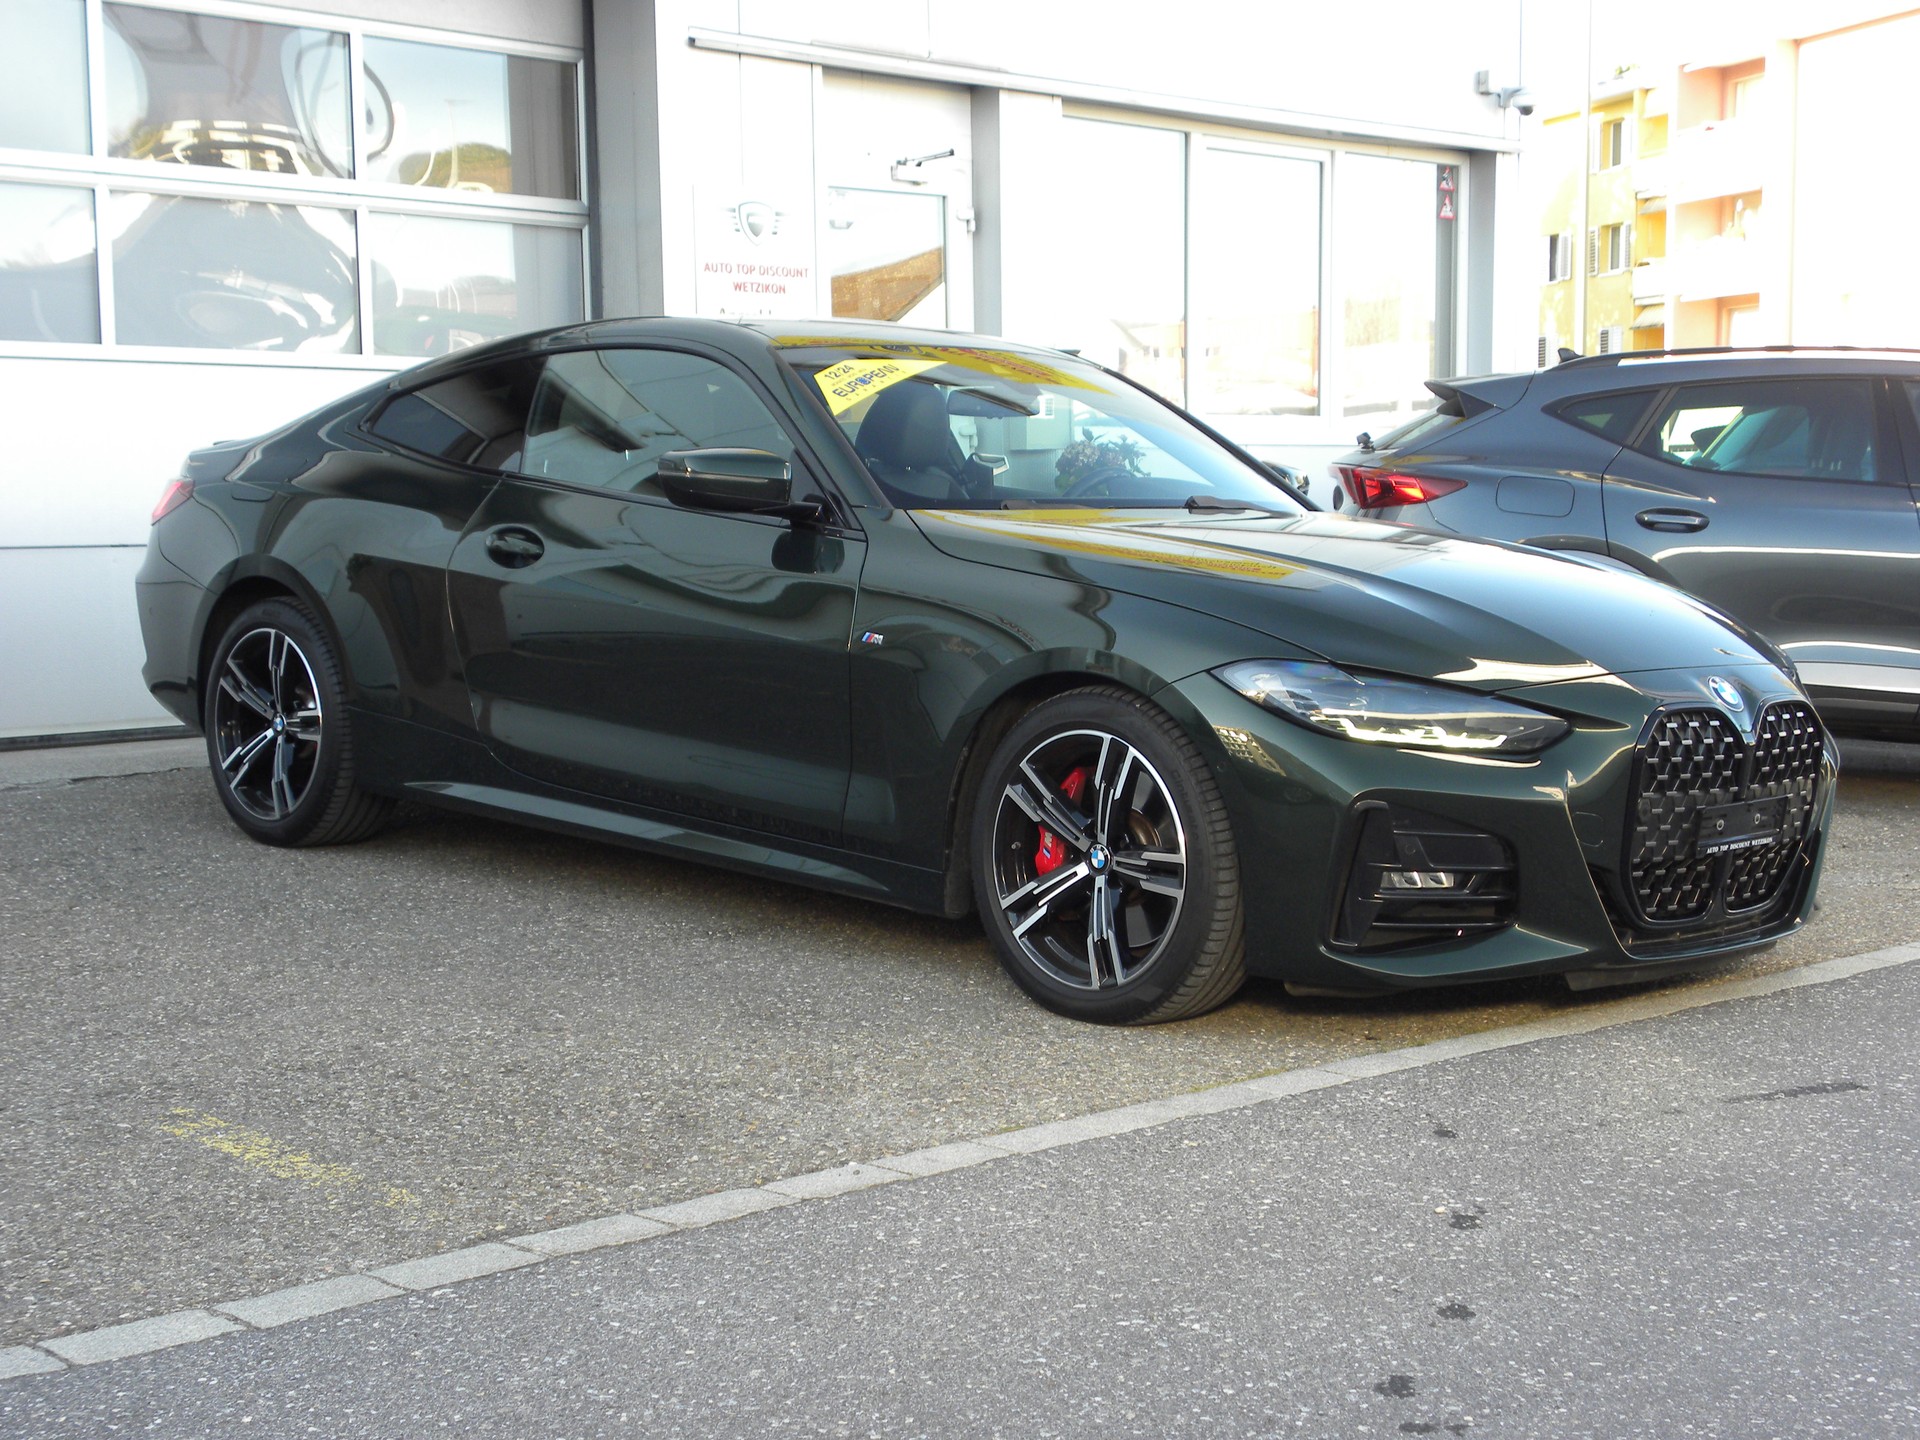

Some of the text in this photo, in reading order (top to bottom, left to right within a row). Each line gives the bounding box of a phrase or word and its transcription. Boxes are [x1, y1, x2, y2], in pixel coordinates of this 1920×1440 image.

[704, 262, 809, 278] AUTO TOP DISCOUNT
[732, 281, 786, 294] WETZIKON
[1706, 846, 1719, 854] AUTO
[1720, 844, 1729, 852] TOP
[1730, 841, 1751, 850] DISCOUNT
